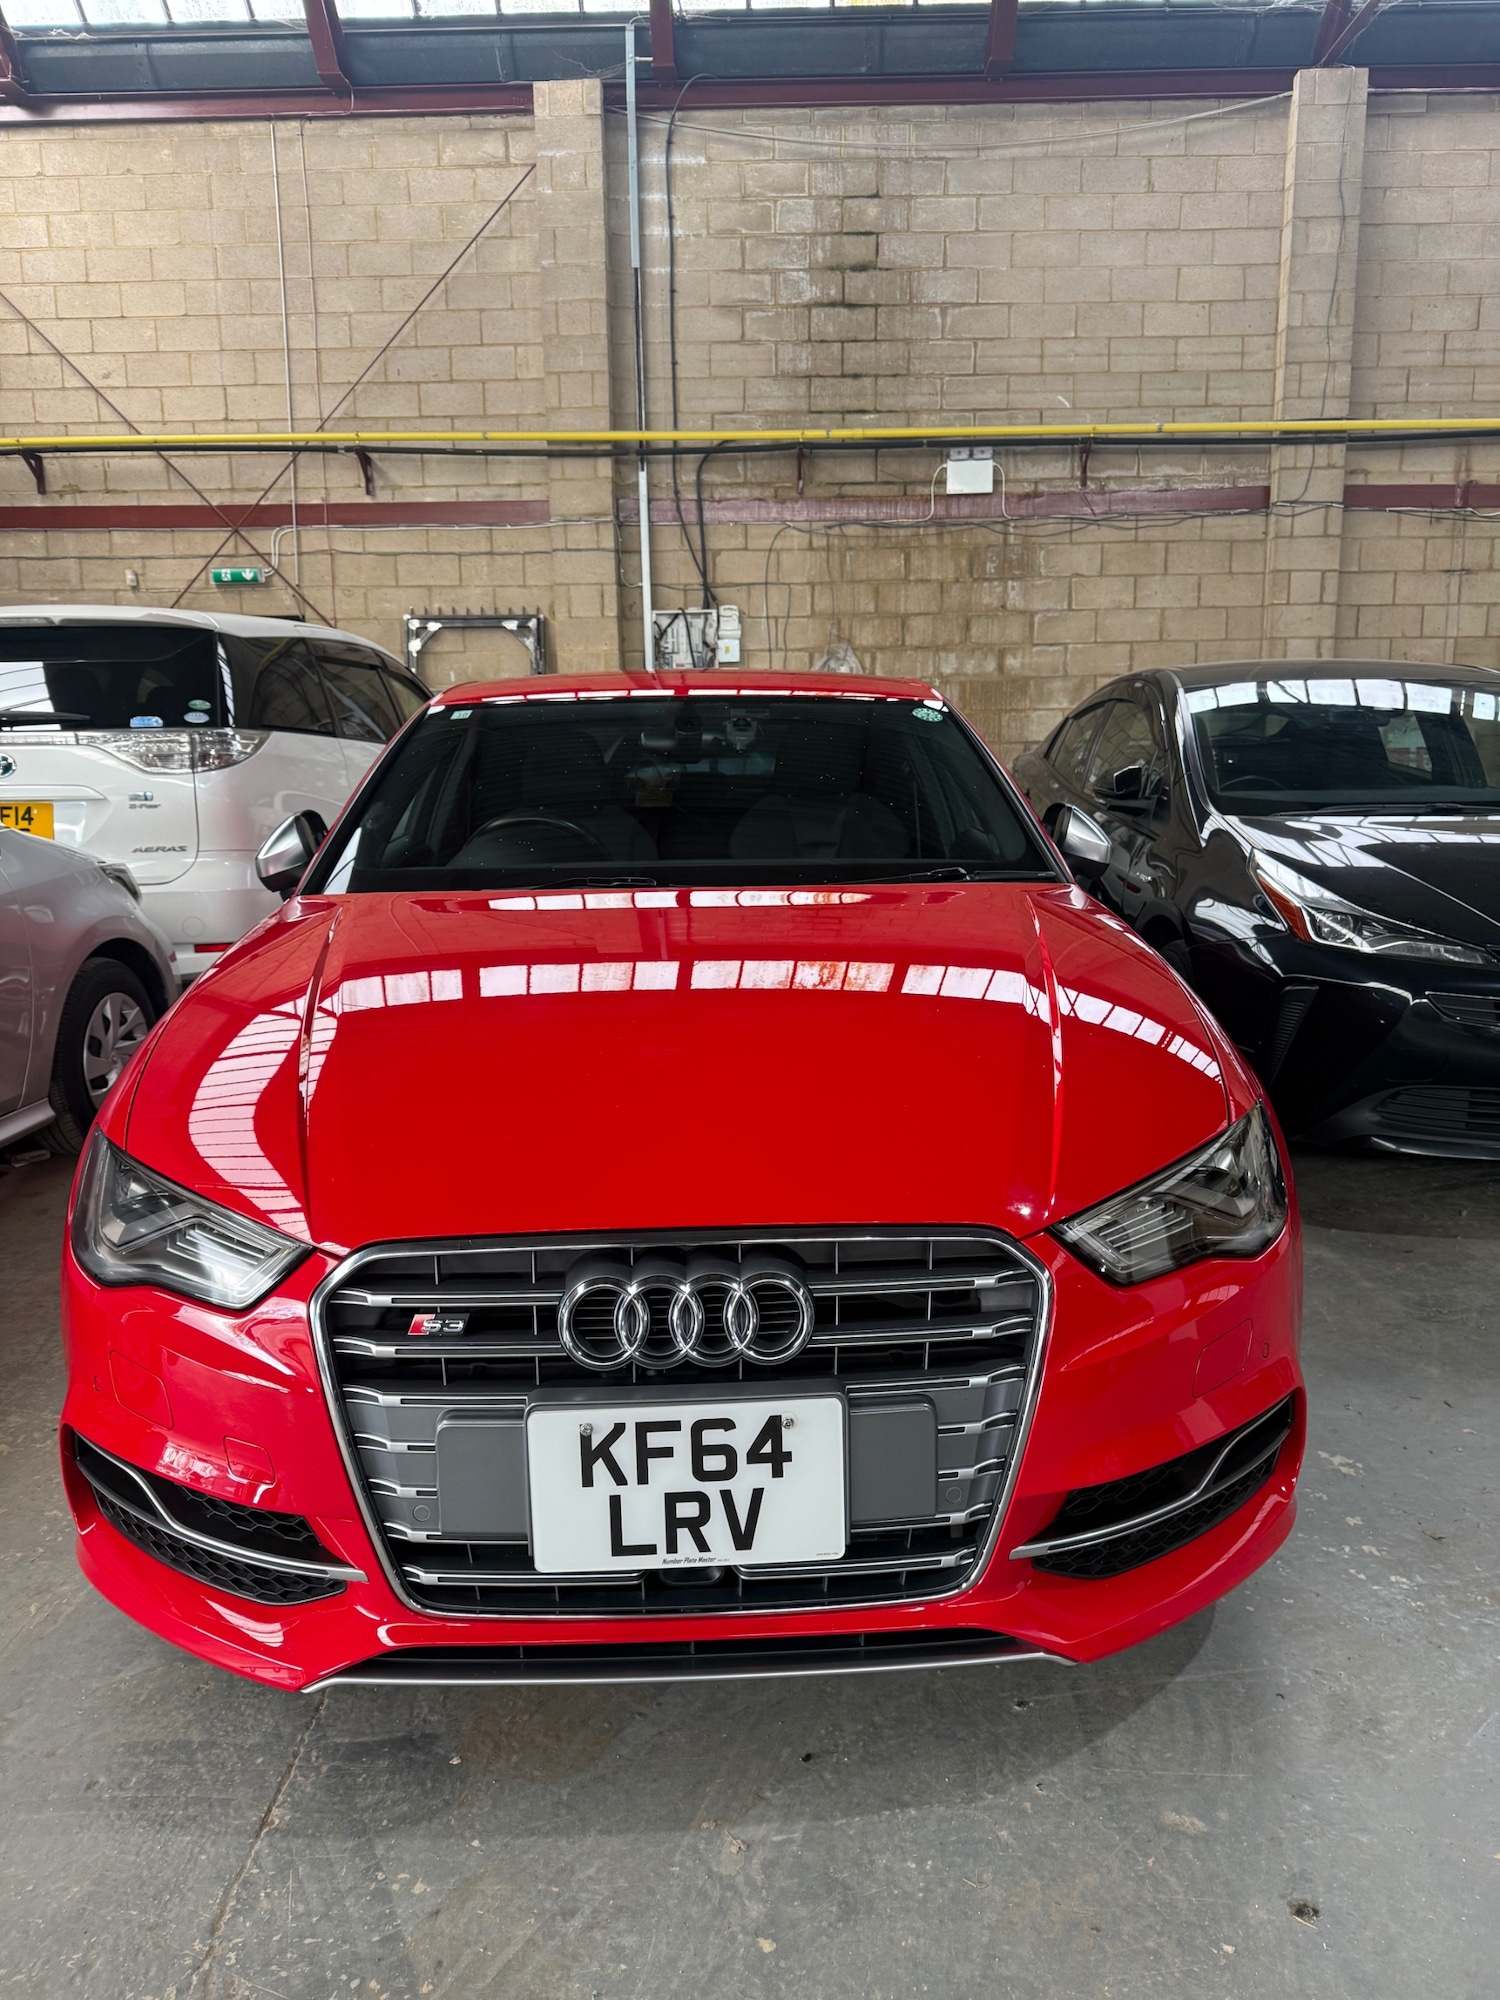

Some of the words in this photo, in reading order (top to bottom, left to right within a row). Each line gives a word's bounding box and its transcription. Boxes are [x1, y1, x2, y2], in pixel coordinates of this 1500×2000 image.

[420, 1319, 464, 1332] S3
[579, 1414, 793, 1488] KF64
[609, 1487, 765, 1557] LRV
[684, 1556, 697, 1564] Plate
